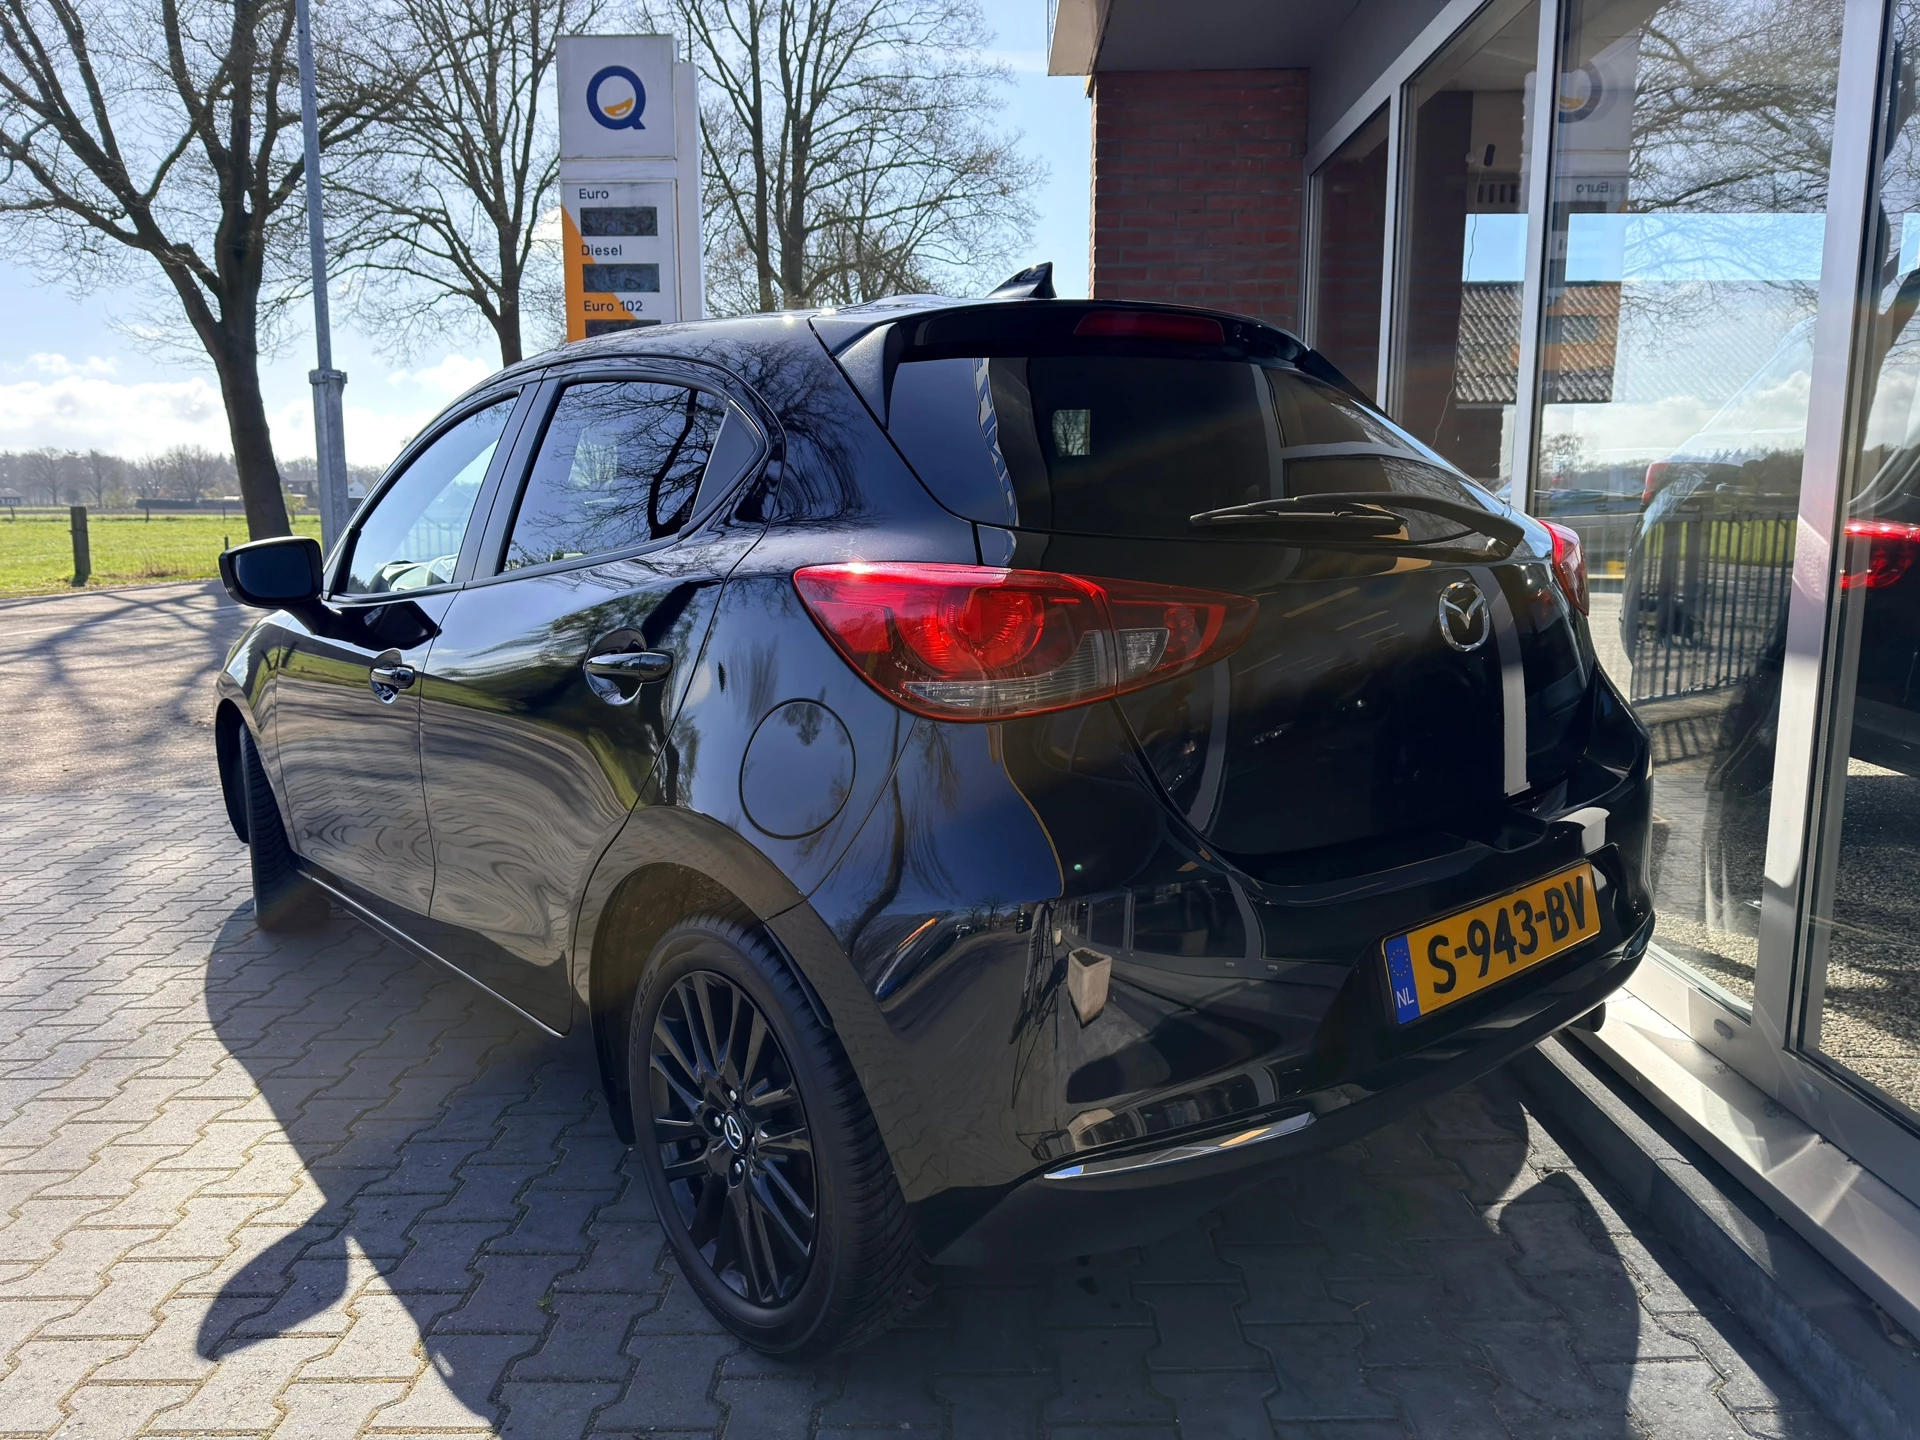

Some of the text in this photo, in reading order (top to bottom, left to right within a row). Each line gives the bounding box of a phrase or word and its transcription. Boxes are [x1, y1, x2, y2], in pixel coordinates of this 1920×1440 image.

[586, 65, 646, 130] Q
[579, 188, 609, 200] Euro
[581, 244, 622, 256] Diesel
[584, 300, 643, 312] Euro 102
[1427, 875, 1586, 994] S-943-BV
[1396, 987, 1415, 1009] NL
